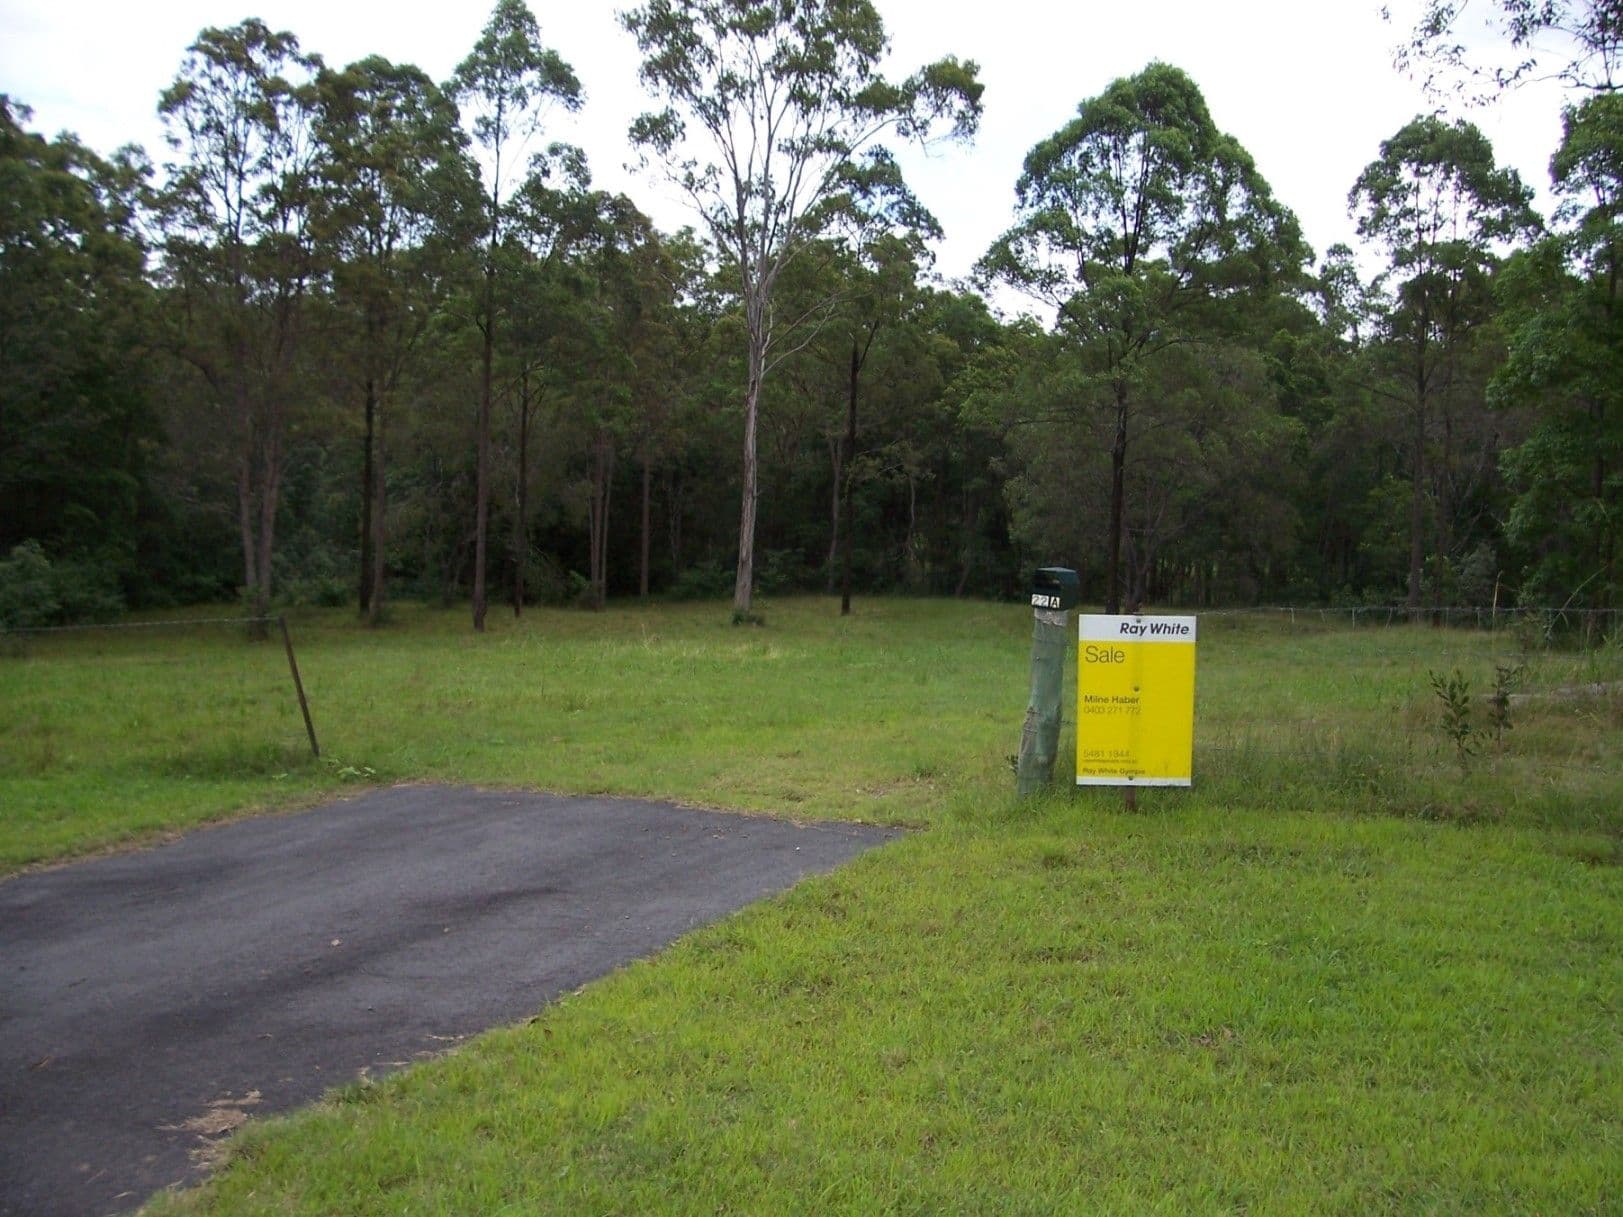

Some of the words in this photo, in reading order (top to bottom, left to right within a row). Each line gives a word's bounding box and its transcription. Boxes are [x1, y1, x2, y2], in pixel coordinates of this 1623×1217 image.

[1120, 622, 1147, 636] Ray
[1150, 623, 1190, 635] White
[1085, 645, 1125, 663] Sale
[1084, 695, 1109, 704] Milne
[1111, 695, 1140, 704] Haber
[1083, 767, 1097, 775] Ray
